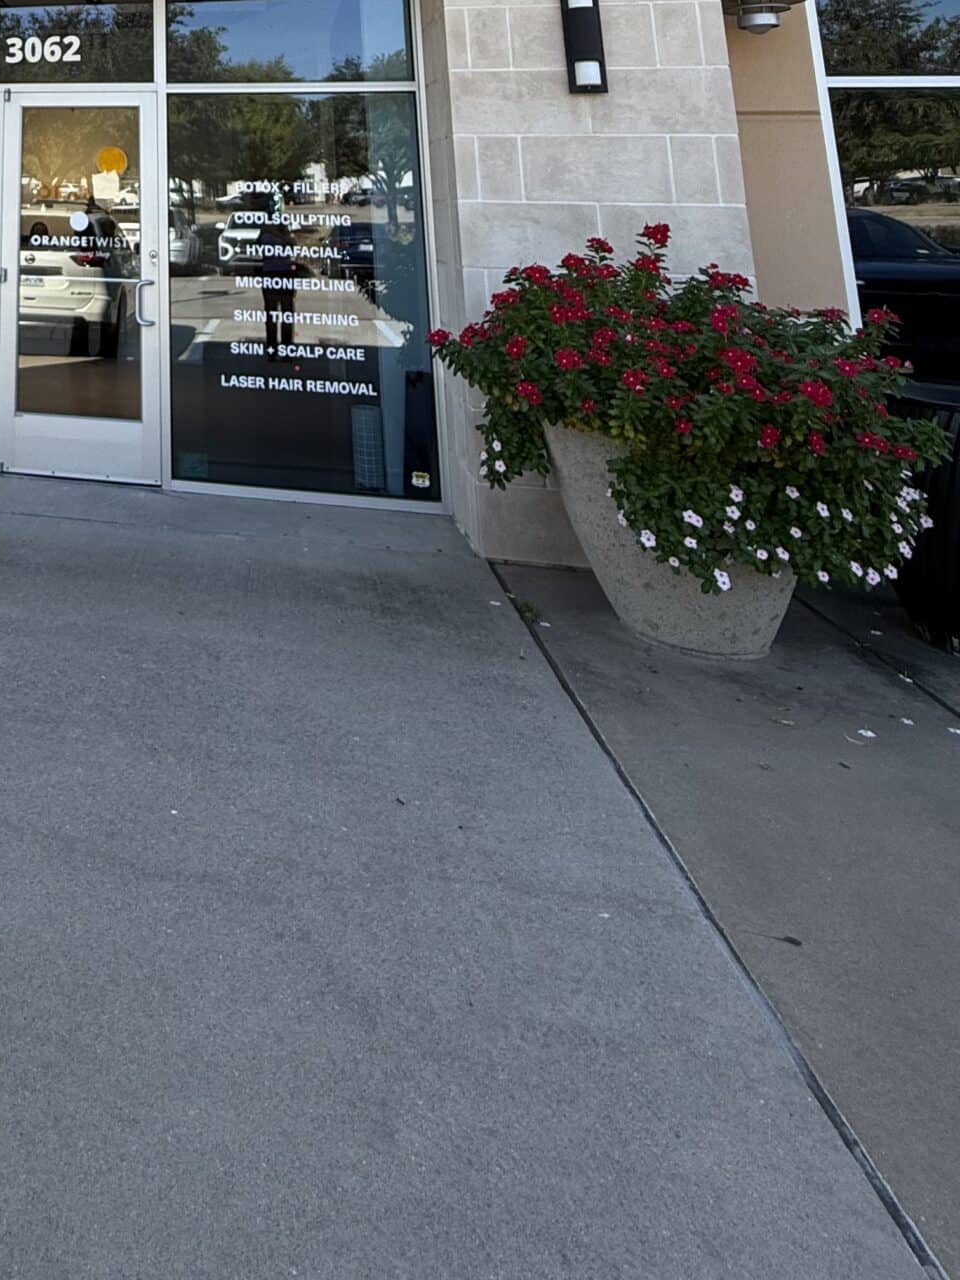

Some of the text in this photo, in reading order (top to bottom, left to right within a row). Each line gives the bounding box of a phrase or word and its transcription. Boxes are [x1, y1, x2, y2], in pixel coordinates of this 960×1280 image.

[5, 35, 82, 64] 3062
[235, 181, 280, 193] BOTOX
[234, 213, 352, 226] COOLSCULPTING
[30, 234, 128, 249] ORANGETWIST
[245, 244, 343, 258] HYDRAFACIAL
[234, 276, 355, 292] MICRONEEDLING
[233, 309, 360, 327] SKIN TIGHTENING
[230, 342, 366, 361] SKIN + SCALP CARE
[220, 374, 378, 396] LASER HAIR REMOVAL
